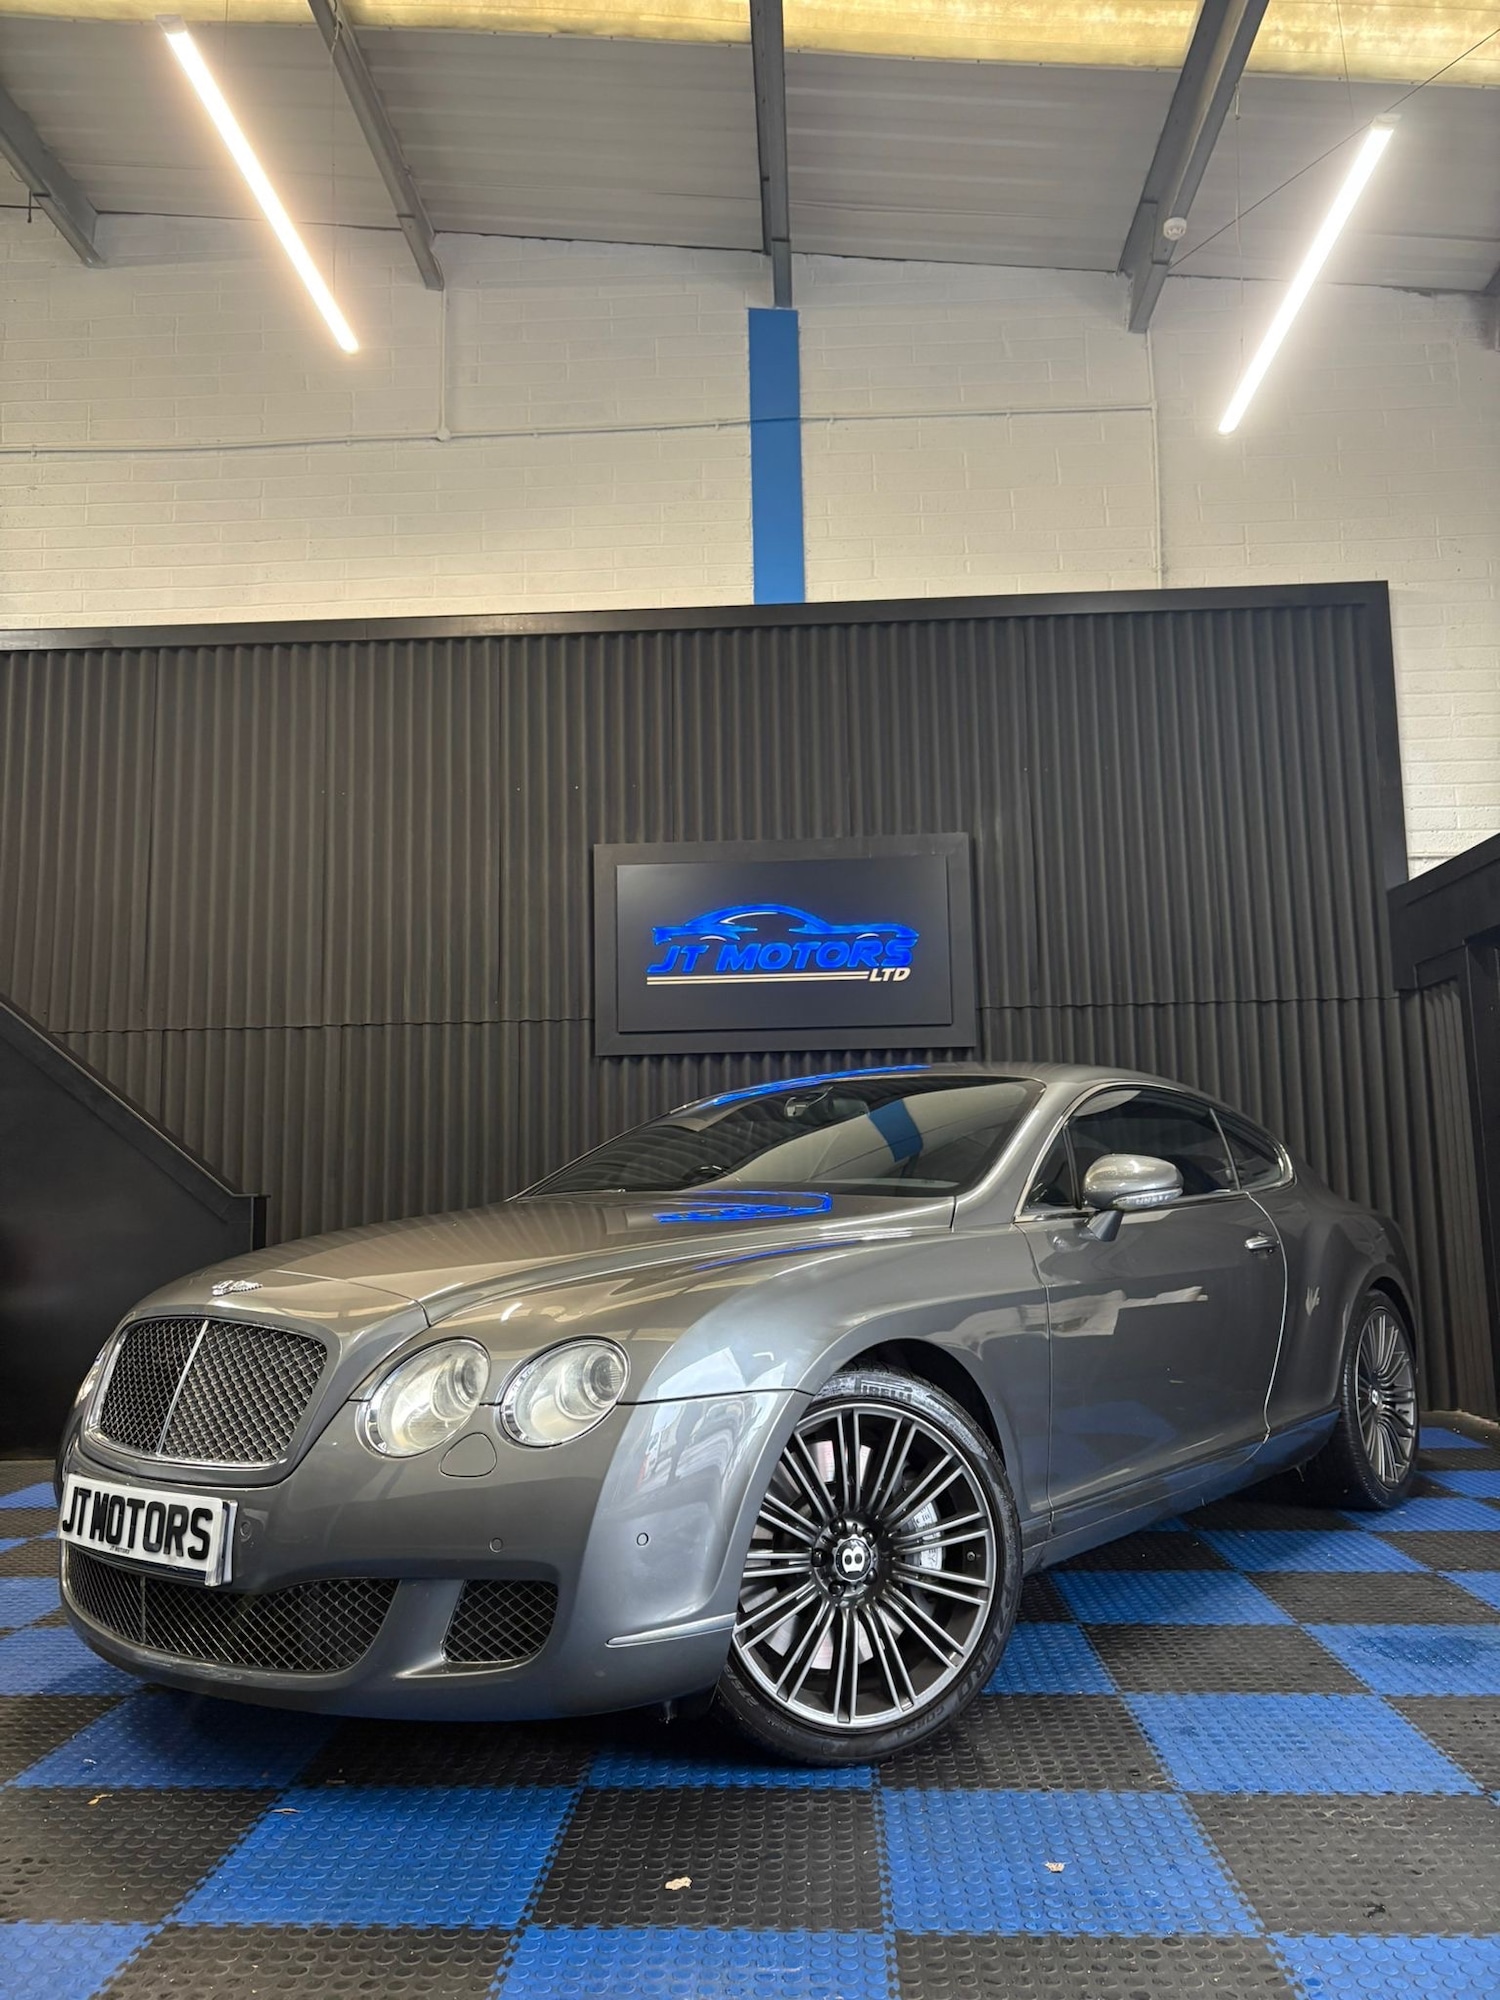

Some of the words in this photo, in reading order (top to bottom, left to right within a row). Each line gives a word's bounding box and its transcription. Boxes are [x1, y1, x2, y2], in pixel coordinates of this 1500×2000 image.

[647, 944, 709, 973] JT
[716, 938, 918, 971] MOTORS
[869, 966, 910, 982] LTD
[855, 1376, 913, 1403] PIRELLI
[62, 1486, 92, 1536] JT
[89, 1491, 213, 1560] MOTORS
